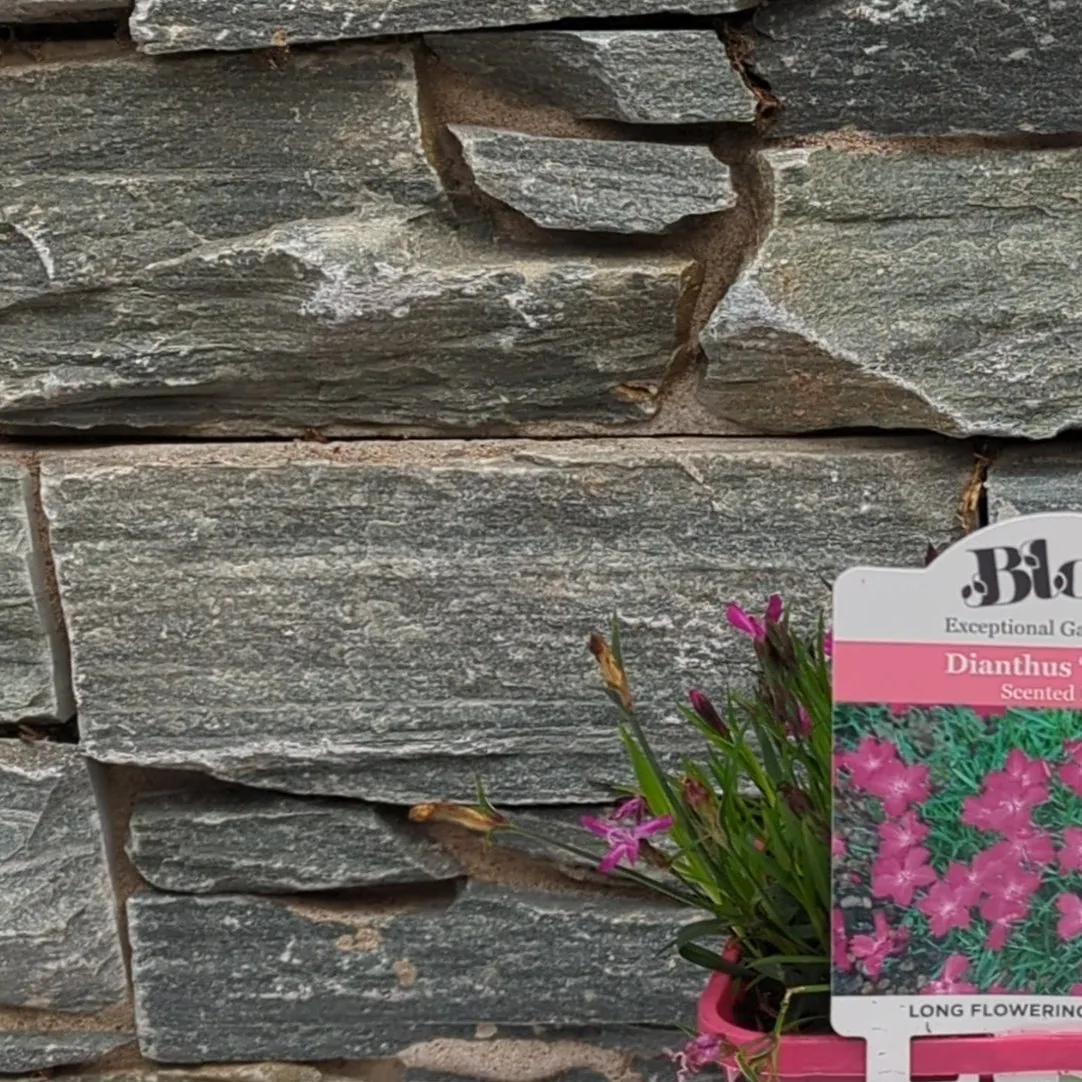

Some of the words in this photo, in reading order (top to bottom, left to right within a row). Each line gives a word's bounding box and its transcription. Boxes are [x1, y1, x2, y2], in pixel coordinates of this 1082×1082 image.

[945, 618, 1054, 638] Exceptional
[944, 652, 1072, 677] Dianthus
[1001, 684, 1075, 701] Scented
[909, 1003, 964, 1018] LONG
